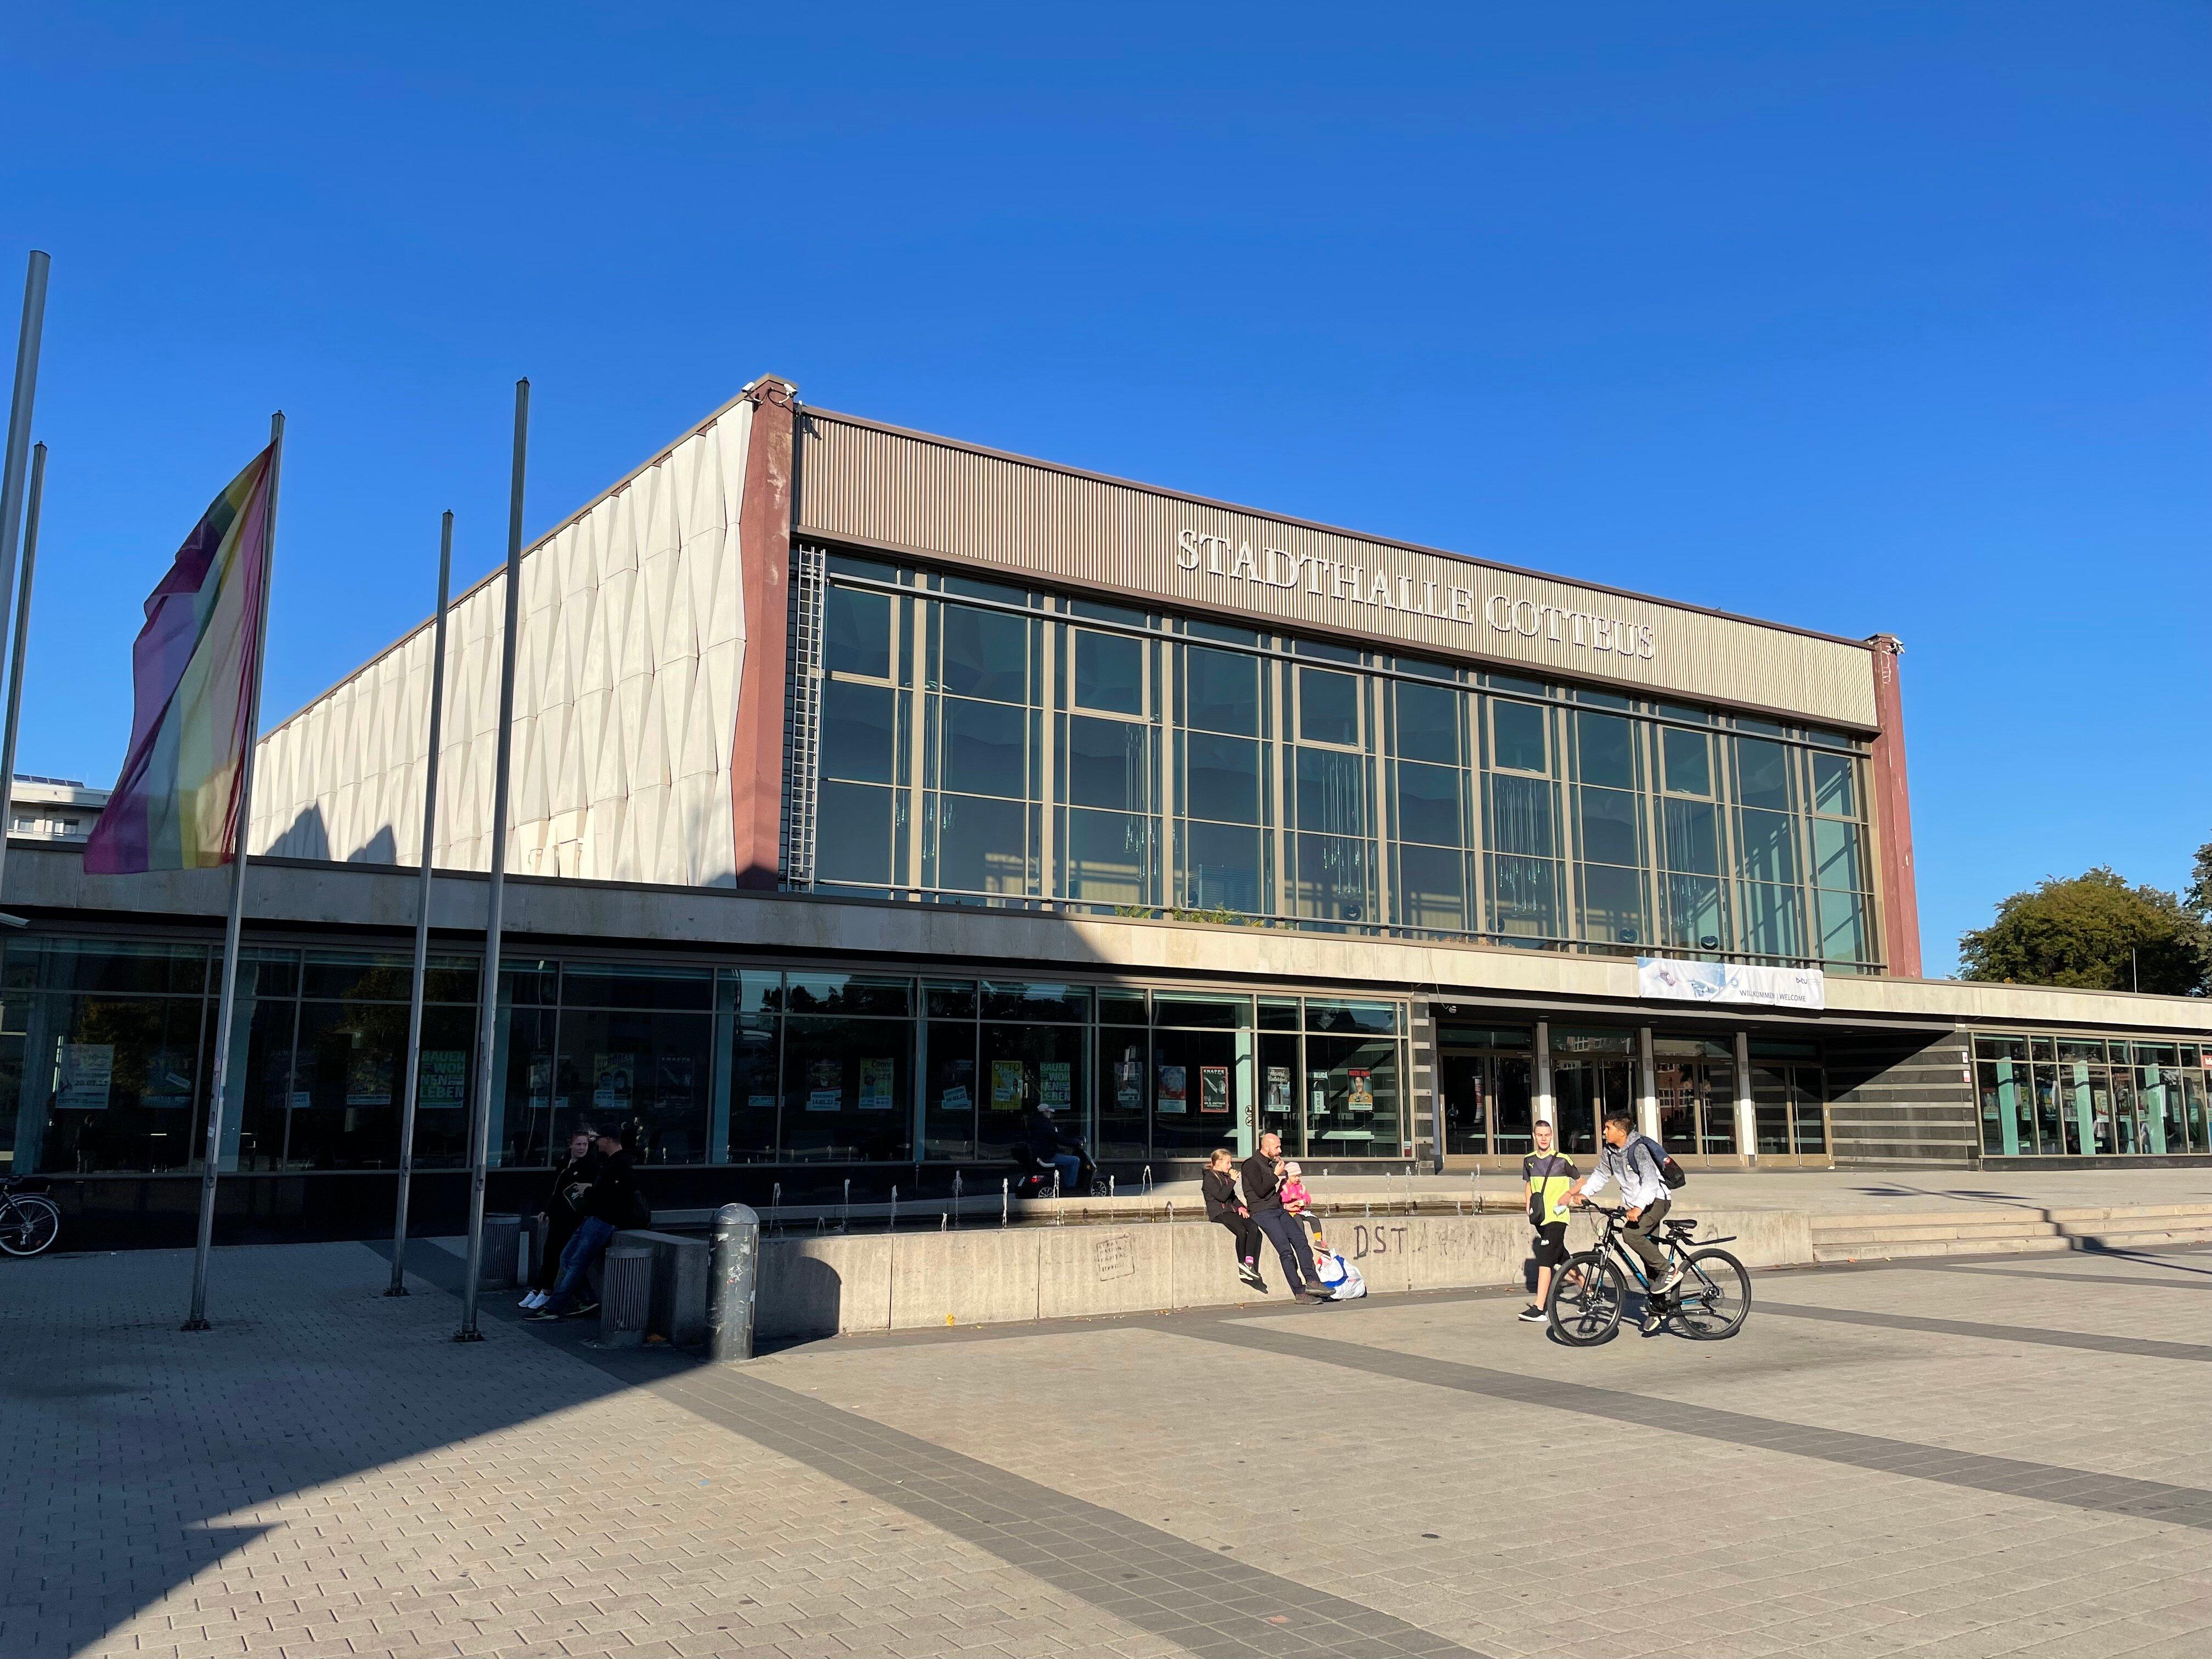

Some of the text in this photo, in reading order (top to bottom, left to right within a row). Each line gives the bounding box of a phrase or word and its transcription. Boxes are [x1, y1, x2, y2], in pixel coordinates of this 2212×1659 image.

[1177, 528, 1654, 659] STADTHALLE COTTBUS
[1739, 990, 1775, 999] WILLKOMMEN
[1780, 994, 1807, 1002] WELCOME
[422, 1051, 466, 1062] BAUEN
[994, 1062, 1020, 1072] OTTO
[1040, 1063, 1070, 1071] BAUEN
